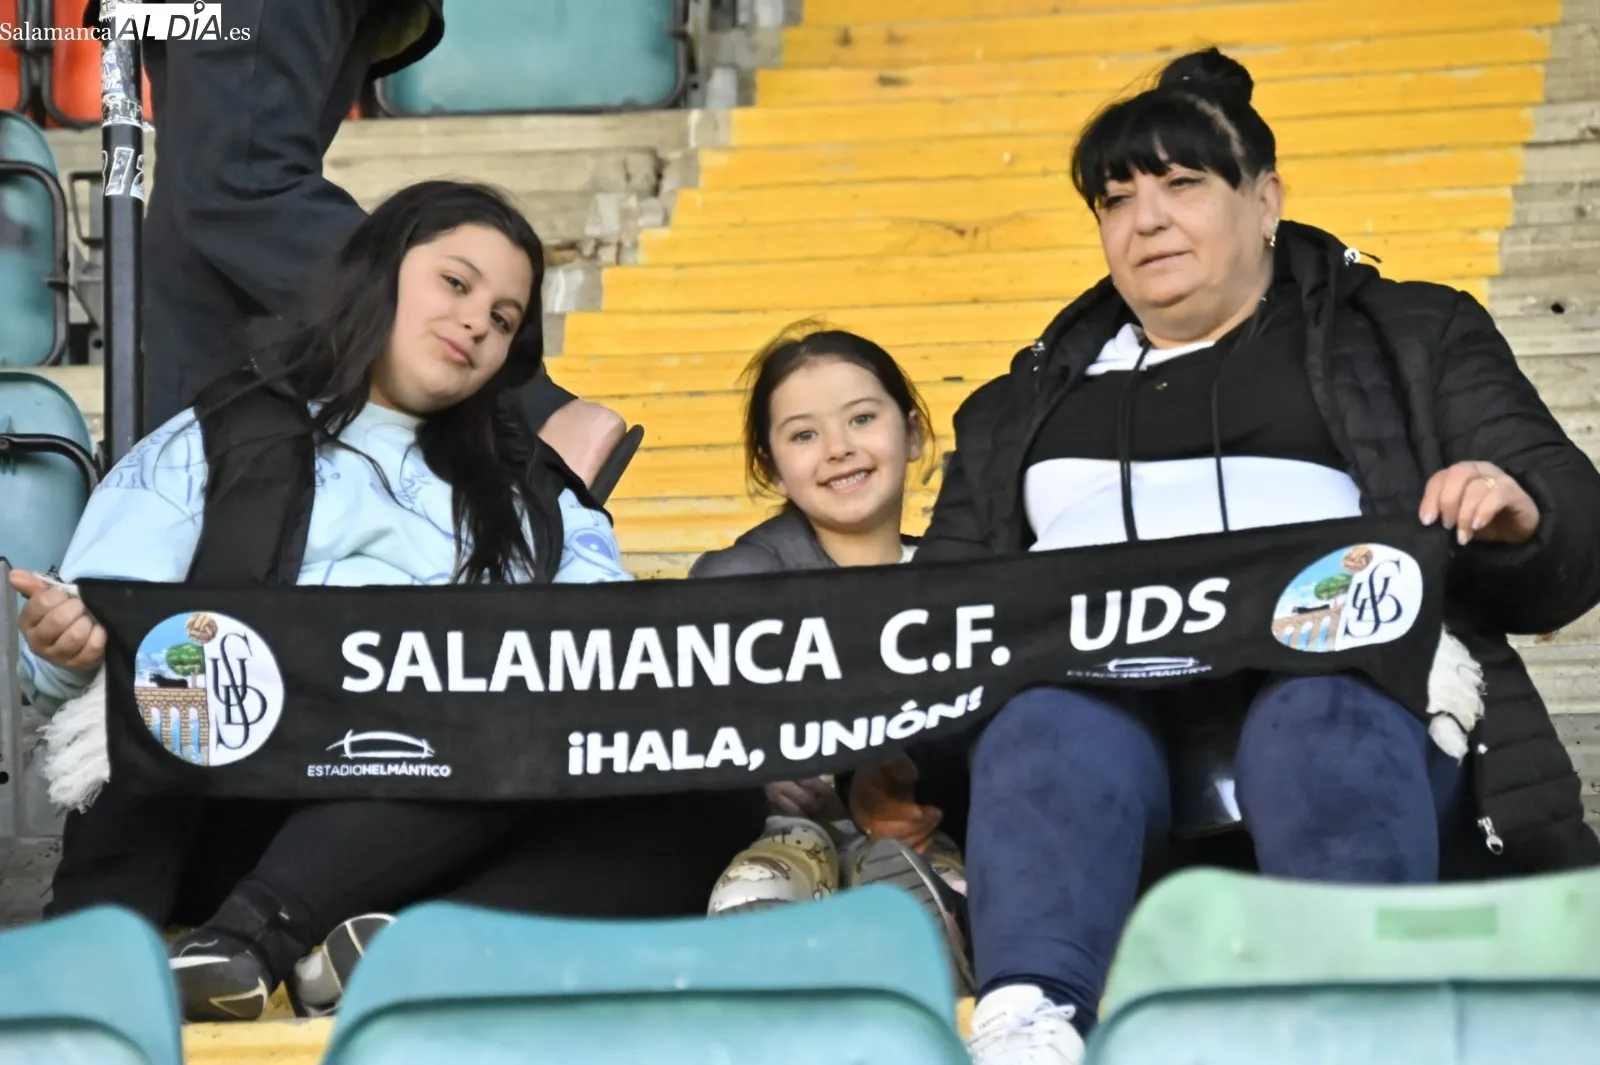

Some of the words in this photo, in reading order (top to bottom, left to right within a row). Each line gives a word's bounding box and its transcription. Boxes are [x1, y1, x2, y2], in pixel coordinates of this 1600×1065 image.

[341, 616, 843, 693] SALAMANCA
[879, 604, 1011, 675] C.F.
[1069, 577, 1231, 652] UDS
[567, 727, 766, 775] ¡HALA,
[779, 685, 984, 761] UNIÓN!
